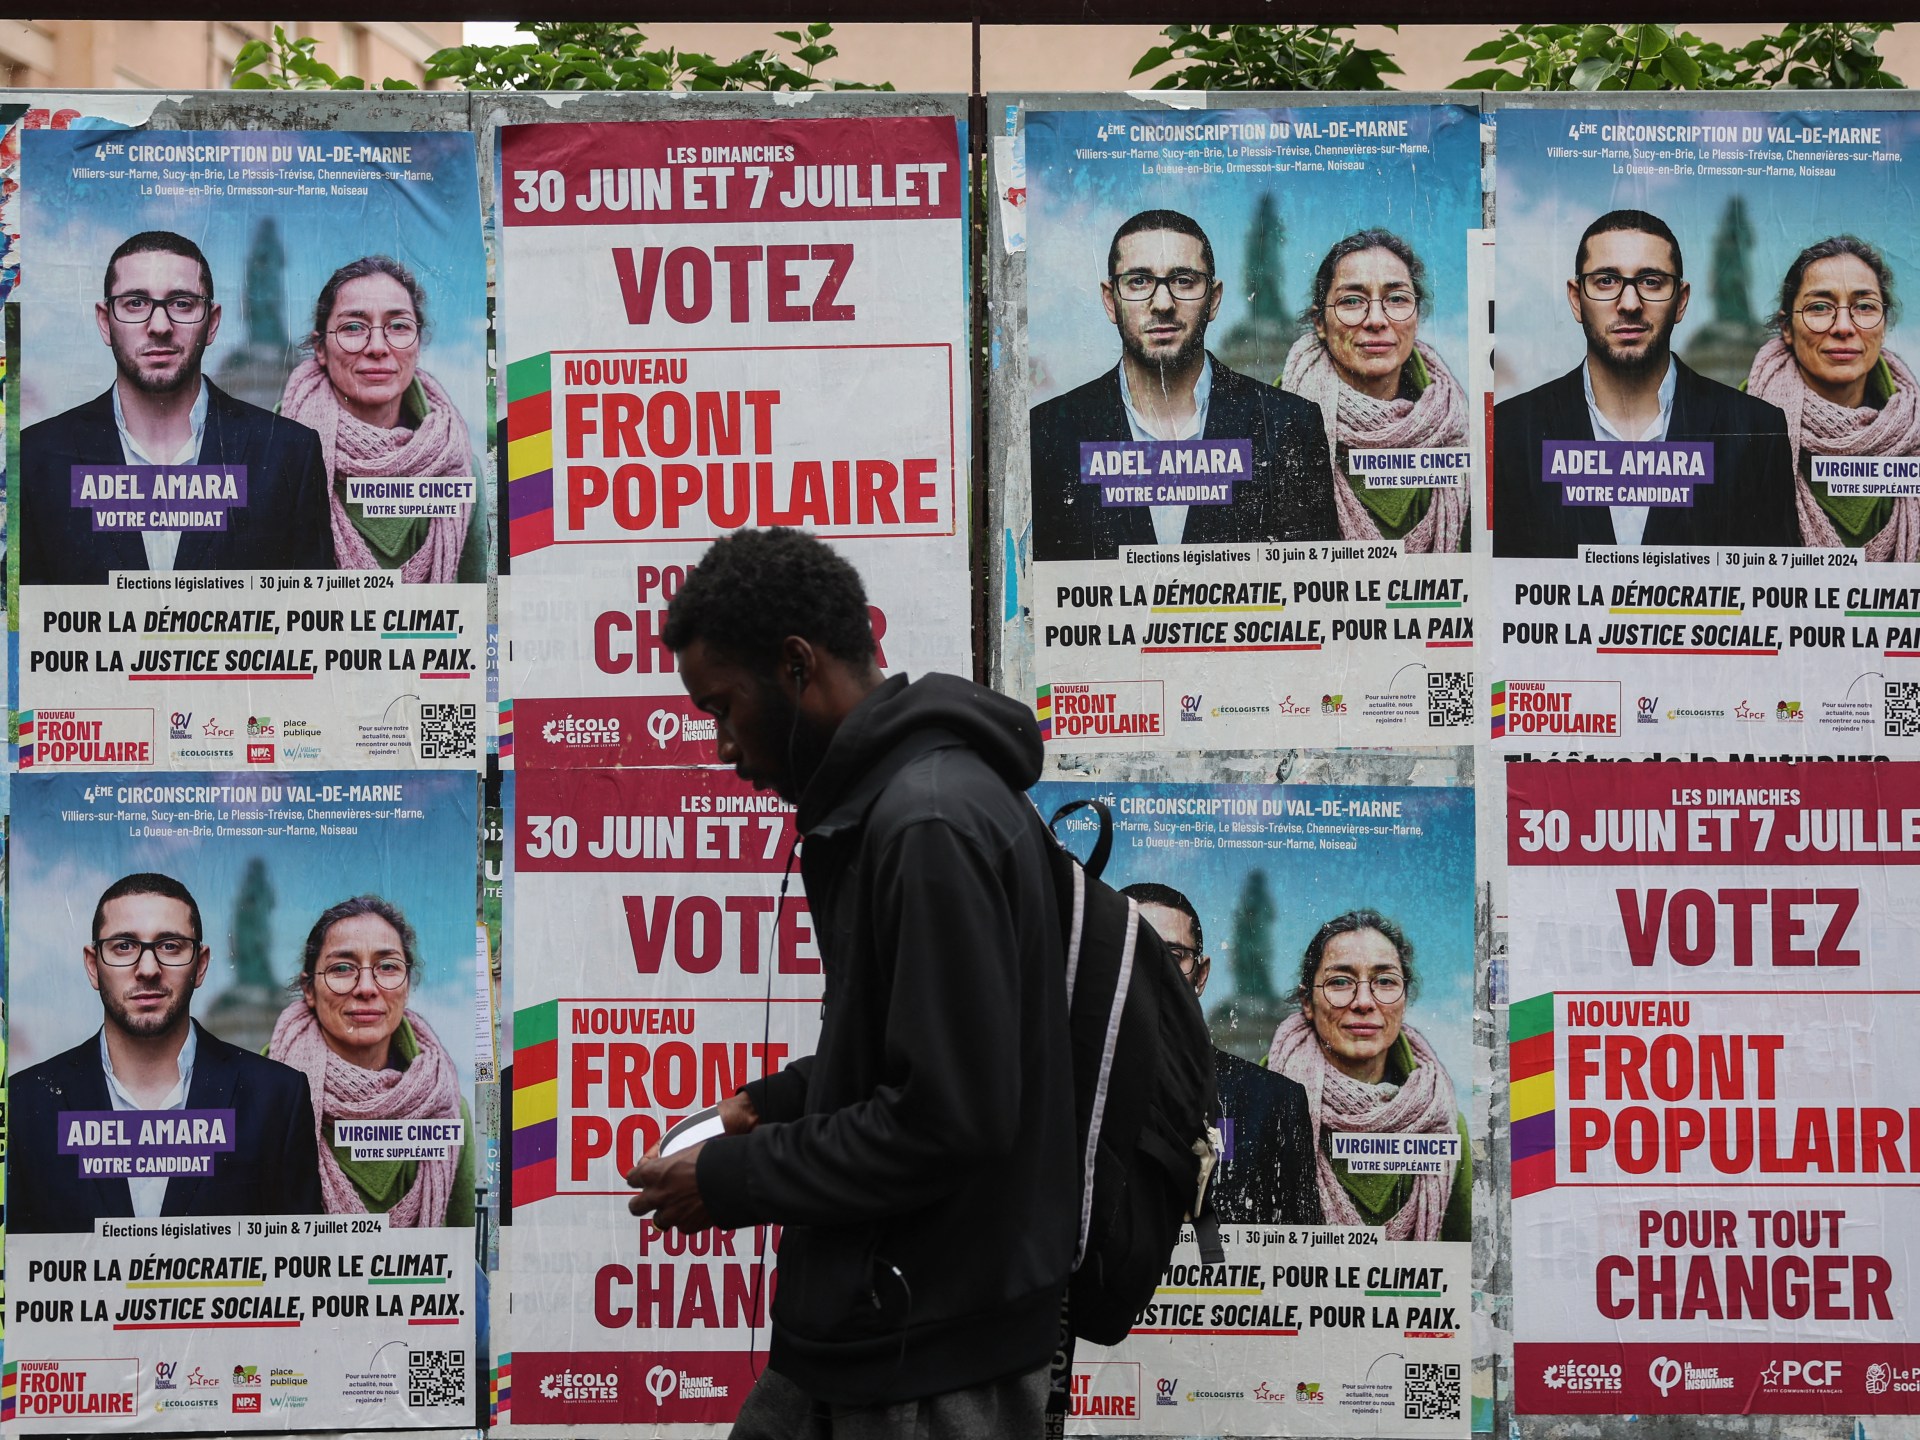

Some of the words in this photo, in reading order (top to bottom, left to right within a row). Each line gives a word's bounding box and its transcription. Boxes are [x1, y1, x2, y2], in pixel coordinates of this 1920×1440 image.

[1097, 123, 1126, 142] 4ÈME
[1130, 123, 1265, 143] CIRCONSCRIPTION
[1269, 123, 1290, 140] DU
[1294, 119, 1408, 140] VAL-DE-MARNE
[95, 143, 124, 161] 4ÈME
[129, 145, 267, 163] CIRCONSCRIPTION
[272, 146, 293, 163] DU
[297, 146, 412, 163] VAL-DE-MARNE
[667, 147, 697, 165] LES
[702, 145, 795, 164] DIMANCHES
[1613, 164, 1623, 174] La
[1627, 164, 1695, 176] Queue-en-Brie,
[1697, 165, 1796, 177] Ormesson-sur-Marne,
[1799, 166, 1835, 177] Noiseau
[514, 169, 565, 213] 30
[576, 168, 671, 211] JUIN
[683, 167, 735, 210] ET
[744, 166, 770, 209] 7
[780, 164, 947, 208] JUILLET
[611, 244, 856, 324] VOTEZ
[564, 358, 687, 386] NOUVEAU
[565, 389, 781, 459] FRONT
[1089, 450, 1152, 476] ADEL
[1159, 448, 1243, 475] AMARA
[1352, 454, 1416, 470] VIRGINIE
[1420, 453, 1473, 469] CINCET
[1550, 450, 1613, 475] ADEL
[1620, 450, 1705, 476] AMARA
[80, 475, 145, 499] ADEL
[152, 474, 238, 499] AMARA
[350, 483, 414, 499] VIRGINIE
[419, 483, 472, 498] CINCET
[567, 458, 939, 532] POPULAIRE
[1566, 486, 1614, 502] VOTRE
[1618, 486, 1690, 503] CANDIDAT
[96, 512, 146, 527] VOTRE
[150, 511, 223, 527] CANDIDAT
[1057, 585, 1113, 608] POUR
[1120, 585, 1147, 606] LA
[1152, 577, 1286, 607] DÉMOCRATIE,
[1293, 581, 1349, 603] POUR
[1356, 580, 1381, 602] LE
[1387, 579, 1468, 604] CLIMAT,
[44, 611, 101, 633] POUR
[109, 611, 136, 632] LA
[143, 605, 280, 634] DÉMOCRATIE,
[287, 610, 344, 632] POUR
[351, 610, 376, 632] LE
[383, 610, 464, 634] CLIMAT,
[30, 650, 88, 673] POUR
[95, 650, 124, 672] LA
[130, 650, 219, 672] JUSTICE
[225, 650, 318, 674] SOCIALE,
[325, 649, 382, 671] POUR
[389, 649, 415, 670] LA
[422, 649, 476, 670] PAIX.
[1509, 682, 1545, 691] NOUVEAU
[1509, 692, 1572, 712] FRONT
[37, 711, 75, 720] NOUVEAU
[565, 713, 620, 732] ÉCOLO
[682, 719, 715, 732] FRANCE
[1509, 712, 1616, 734] POPULAIRE
[37, 721, 102, 741] FRONT
[565, 731, 620, 744] GISTES
[682, 728, 717, 742] INSOUM
[37, 742, 149, 762] POPULAIRE
[681, 796, 711, 813] LES
[716, 796, 798, 814] DIMANCHE
[1121, 797, 1257, 816] CIRCONSCRIPTION
[1262, 799, 1282, 816] DU
[1286, 800, 1401, 818] VAL-DE-MARNE
[1672, 789, 1701, 806] LES
[1706, 789, 1800, 806] DIMANCHES
[61, 809, 149, 823] Villiers-sur-Marne,
[151, 810, 215, 823] Sucy-en-Brie,
[218, 809, 228, 820] Le
[231, 808, 305, 821] Plessis-Trévise,
[307, 808, 423, 821] Chennevières-sur-Marne,
[527, 815, 578, 859] 30
[589, 816, 684, 859] JUIN
[696, 816, 748, 859] ET
[758, 817, 783, 859] 7
[1519, 809, 1570, 852] 30
[1581, 809, 1675, 851] JUIN
[1687, 809, 1740, 851] ET
[1749, 809, 1775, 852] 7
[1785, 809, 1920, 852] JUILLE
[622, 895, 825, 975] VOTE
[1615, 888, 1861, 966] VOTEZ
[572, 1008, 694, 1035] NOUVEAU
[1567, 1001, 1690, 1027] NOUVEAU
[1567, 1034, 1784, 1101] FRONT
[66, 1120, 132, 1146] ADEL
[139, 1118, 226, 1145] AMARA
[338, 1125, 403, 1142] VIRGINIE
[407, 1125, 461, 1141] CINCET
[354, 1148, 383, 1158] VOTRE
[387, 1146, 445, 1158] SUPPLÉANTE
[1336, 1138, 1400, 1155] VIRGINIE
[1404, 1139, 1457, 1155] CINCET
[102, 1221, 158, 1238] Élections
[161, 1222, 232, 1239] législatives
[247, 1222, 262, 1235] 30
[265, 1222, 287, 1238] juin
[291, 1221, 300, 1234] &
[304, 1221, 311, 1234] 7
[313, 1220, 348, 1237] juillet
[351, 1220, 382, 1233] 2024
[639, 1218, 736, 1257] POUR
[1639, 1210, 1738, 1249] POUR
[1747, 1210, 1846, 1249] TOUT
[594, 1262, 776, 1330] CHAN
[1595, 1255, 1894, 1321] CHANGER
[1132, 1303, 1205, 1327] USTICE
[1210, 1304, 1302, 1330] SOCIALE,
[1310, 1305, 1365, 1328] POUR
[1372, 1307, 1399, 1329] LA
[1405, 1307, 1460, 1330] PAIX.
[21, 1362, 59, 1371] NOUVEAU
[270, 1368, 294, 1376] place
[1567, 1359, 1622, 1378] ÉCOLO
[1684, 1368, 1718, 1380] FRANCE
[1782, 1360, 1842, 1386] PCF
[1893, 1368, 1909, 1379] Le
[20, 1372, 86, 1393] FRONT
[247, 1374, 261, 1384] PS
[270, 1377, 308, 1386] publique
[563, 1368, 618, 1387] ÉCOLO
[679, 1377, 713, 1389] FRANCE
[1567, 1378, 1622, 1390] GISTES
[1684, 1377, 1734, 1390] INSOUMISE
[236, 1397, 257, 1407] NPA
[563, 1387, 618, 1399] GISTES
[679, 1386, 728, 1399] INSOUMISE
[20, 1393, 133, 1414] POPULAIRE
[165, 1399, 219, 1407] ÉCOLOGISTES
